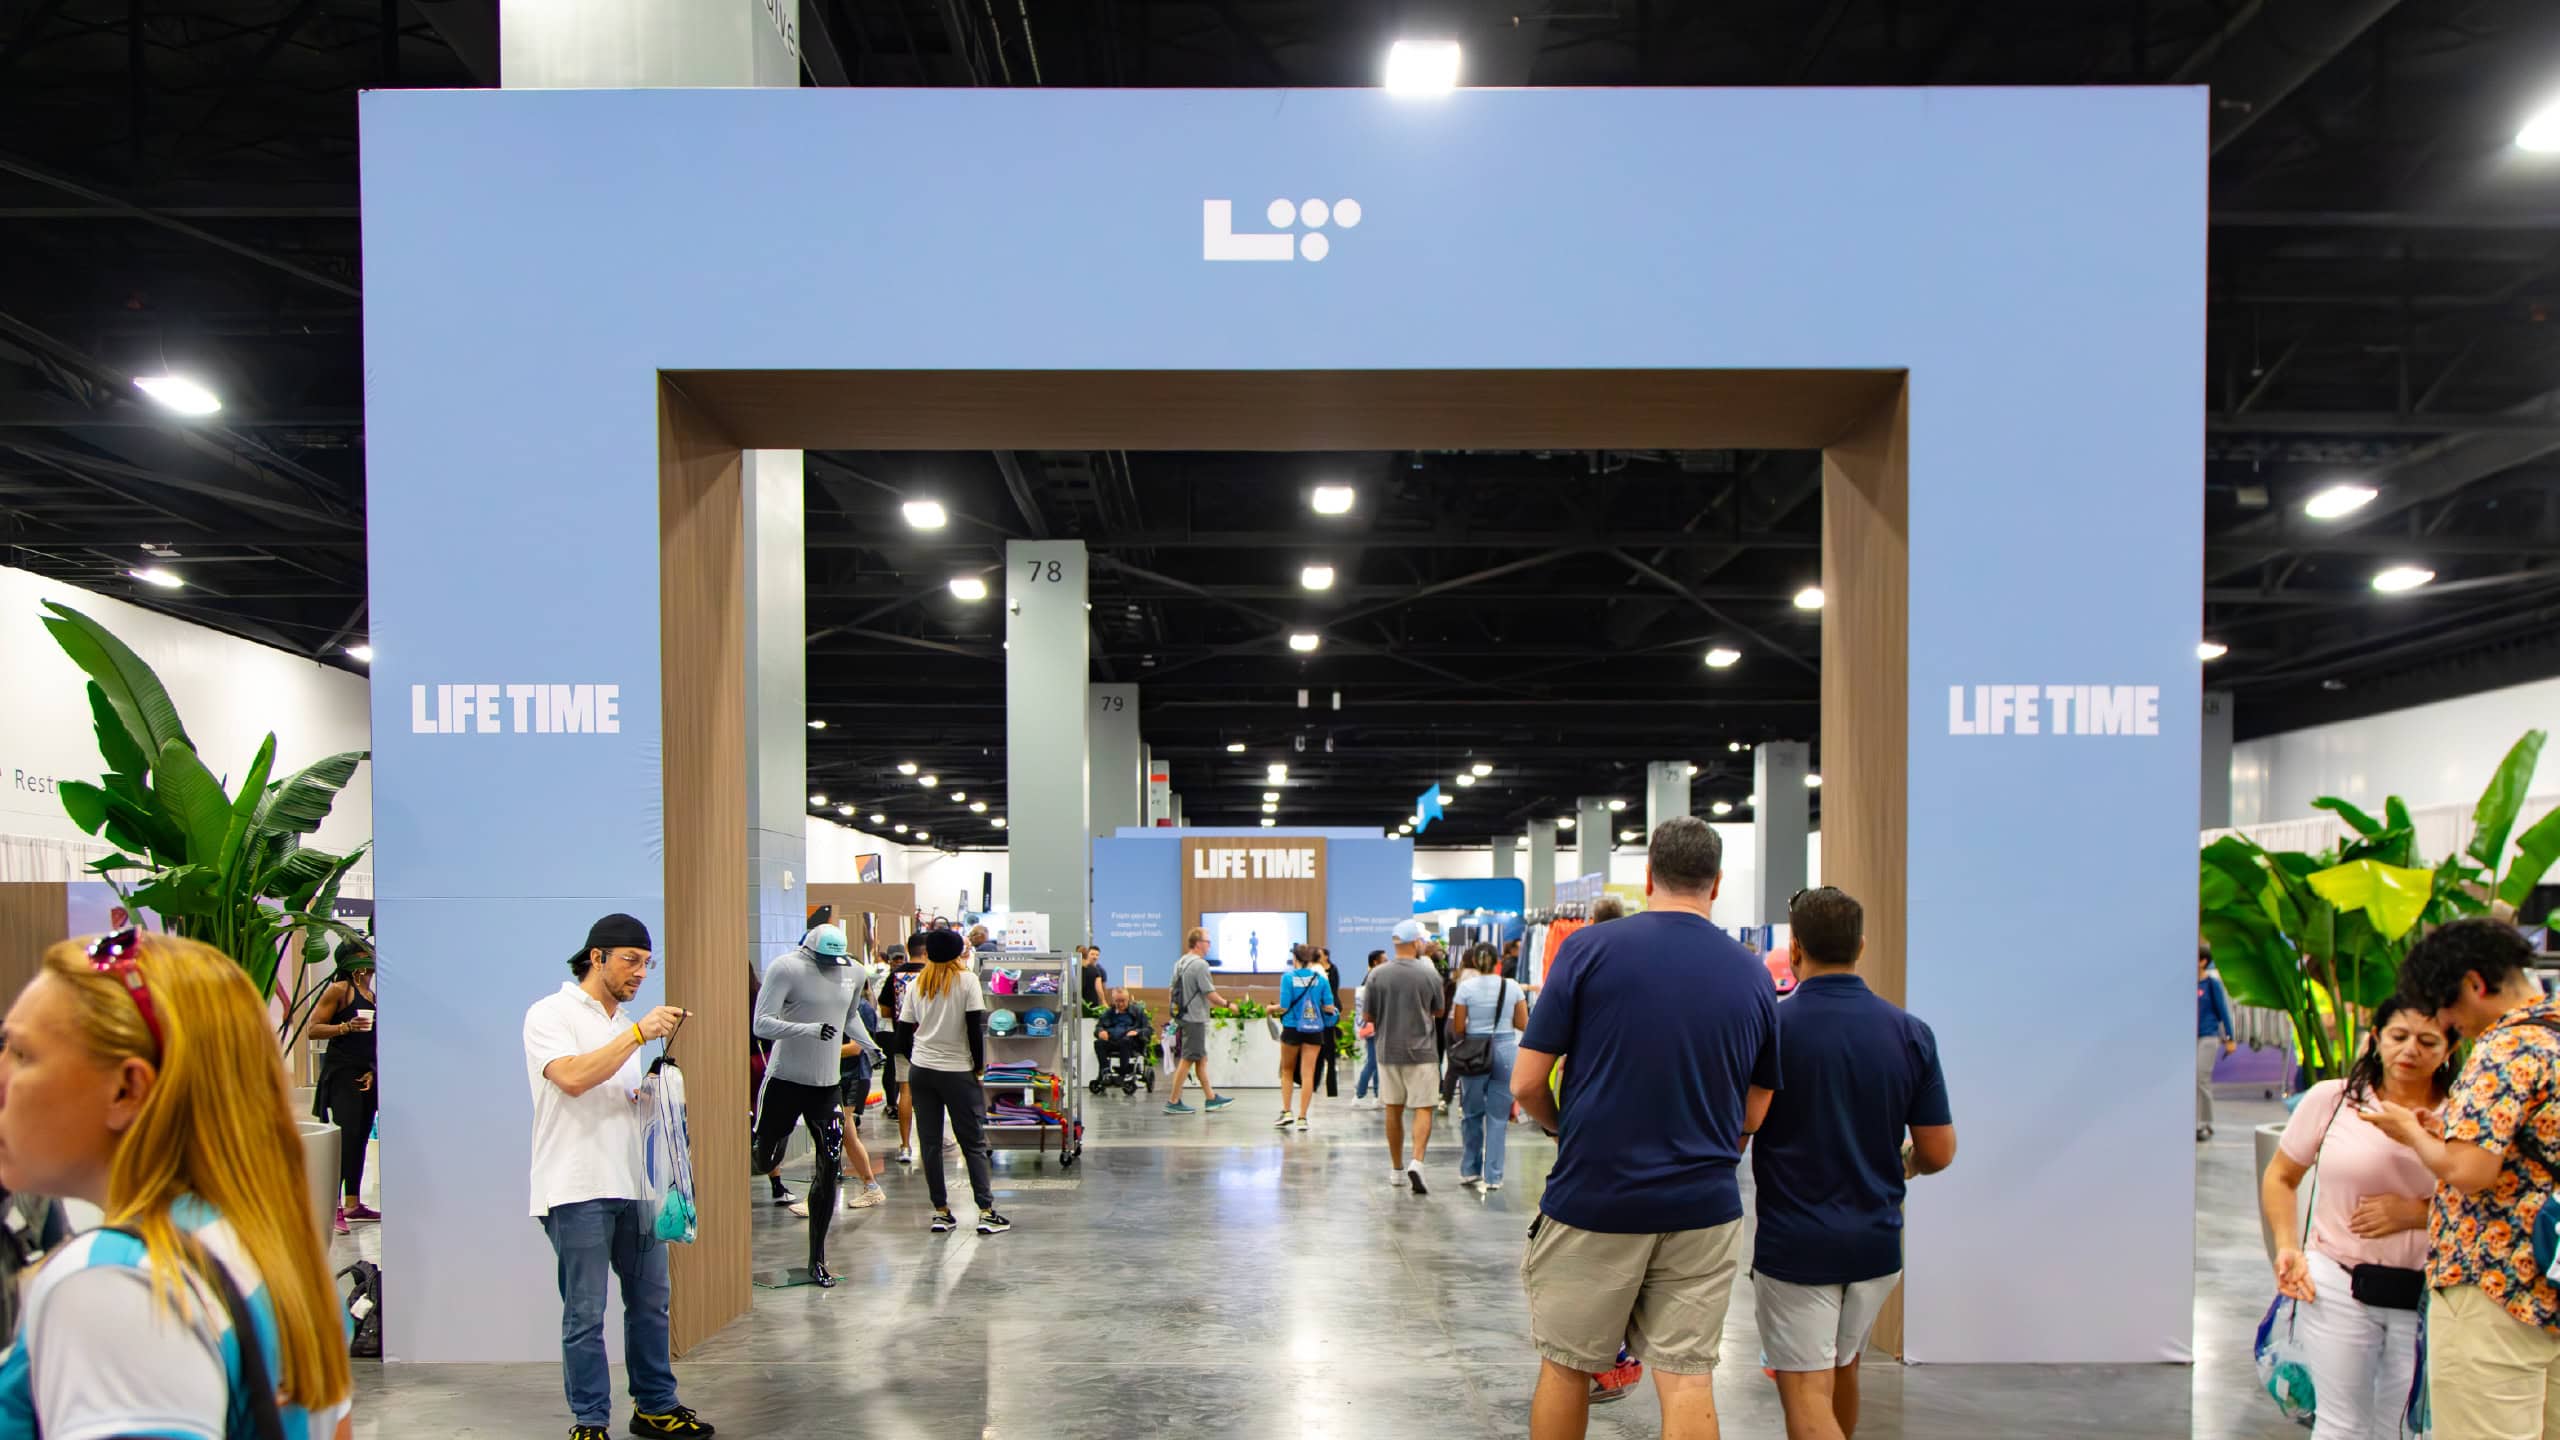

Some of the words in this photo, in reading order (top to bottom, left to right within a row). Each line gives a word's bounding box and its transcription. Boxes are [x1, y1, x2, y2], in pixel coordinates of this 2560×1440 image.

[1027, 560, 1063, 583] 78
[411, 684, 501, 734] LIFE
[506, 684, 620, 734] TIME
[1102, 696, 1124, 711] 79
[1949, 685, 2040, 736] LIFE
[2045, 685, 2160, 736] TIME
[1194, 848, 1246, 879] LIFE
[1249, 848, 1315, 879] TIME
